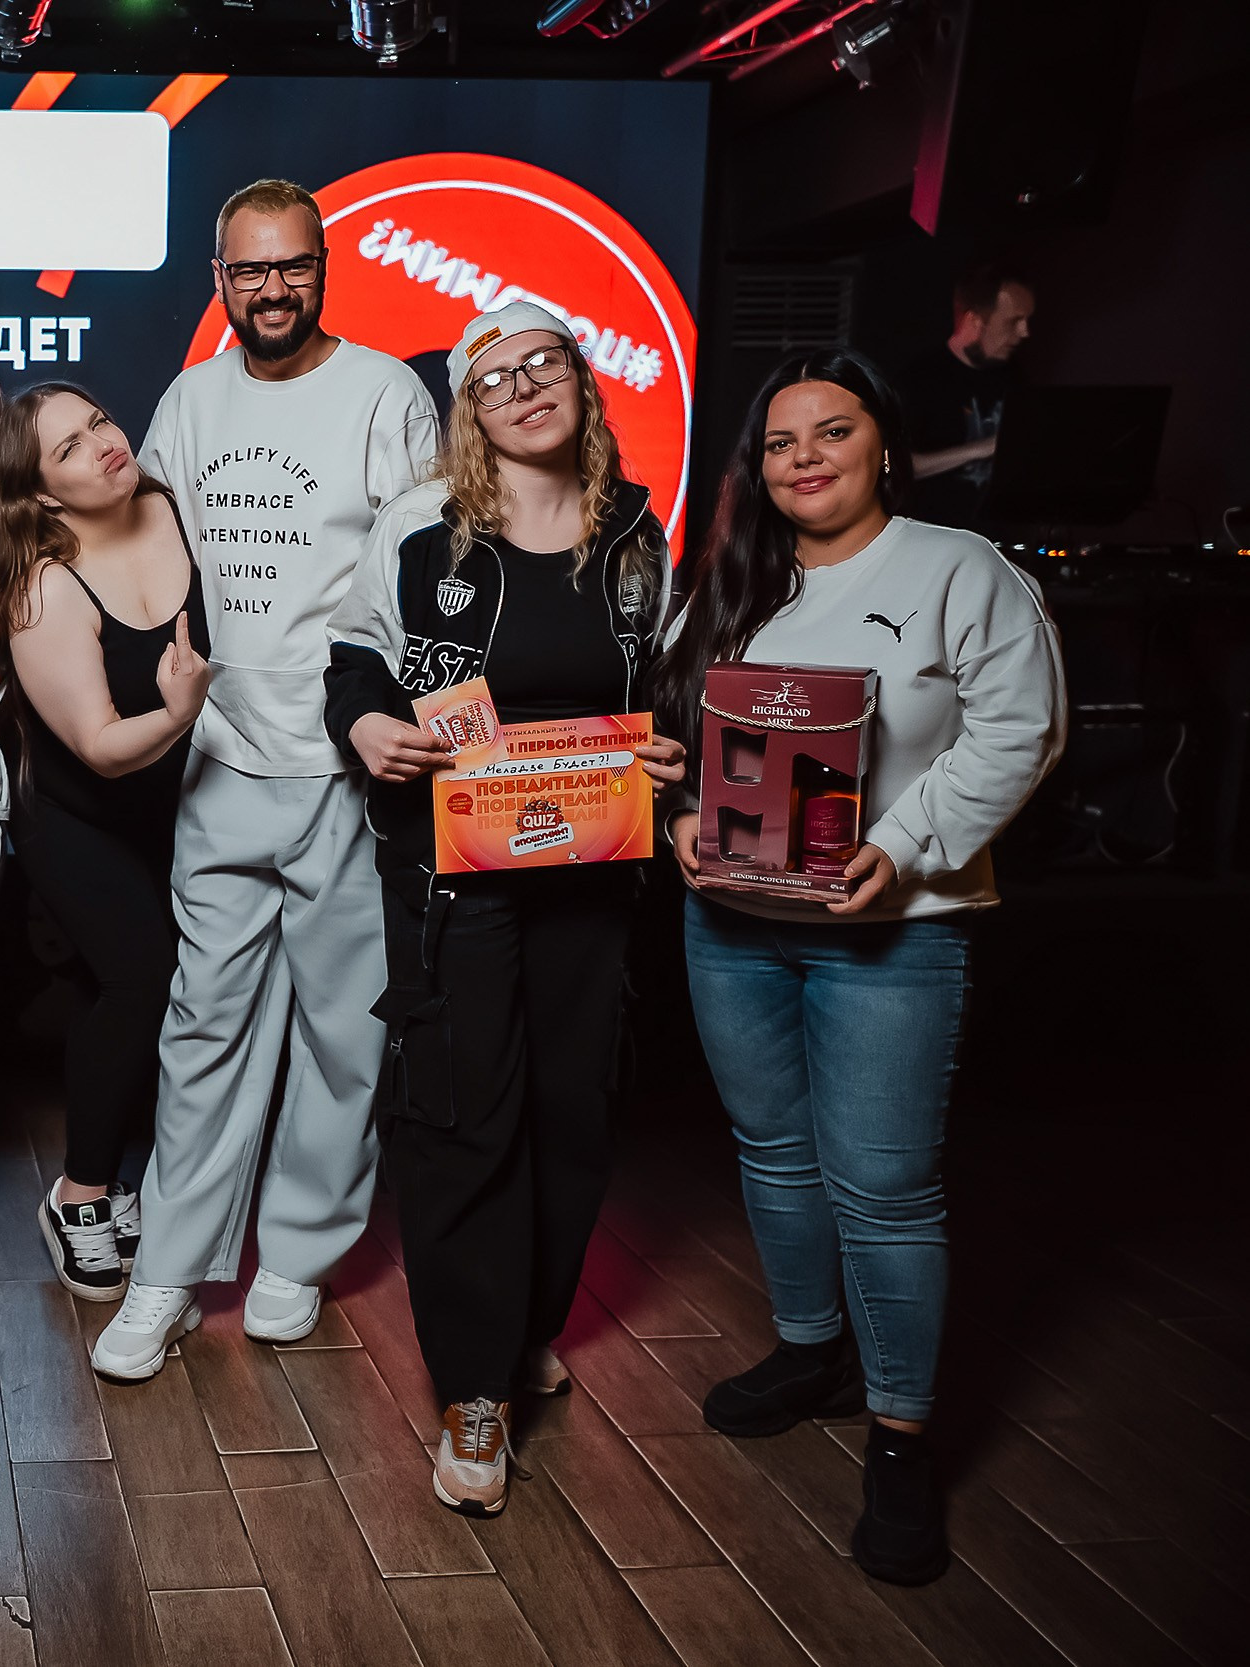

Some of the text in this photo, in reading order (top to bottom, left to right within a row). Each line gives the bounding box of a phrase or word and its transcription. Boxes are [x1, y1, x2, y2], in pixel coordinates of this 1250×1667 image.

[358, 218, 663, 392] #ПОУМИМ?
[194, 446, 319, 495] SIMPLIFY LIFE
[206, 493, 294, 509] EMBRACE
[199, 528, 312, 546] NTENTIONAL
[218, 563, 277, 580] LIVING
[223, 597, 272, 614] DAILY
[751, 705, 811, 718] HIGHLAND
[767, 717, 794, 727] MIST
[451, 719, 466, 743] QUIZ
[518, 735, 577, 753] ПЕРВОЙ
[581, 732, 648, 747] СТЕПЕНИ
[476, 772, 607, 797] ПОБЕДИТЕЛИ!
[615, 781, 622, 793] 1
[522, 813, 556, 828] QUIZ
[729, 872, 812, 887] BLENDED SCOTCH WHISKY
